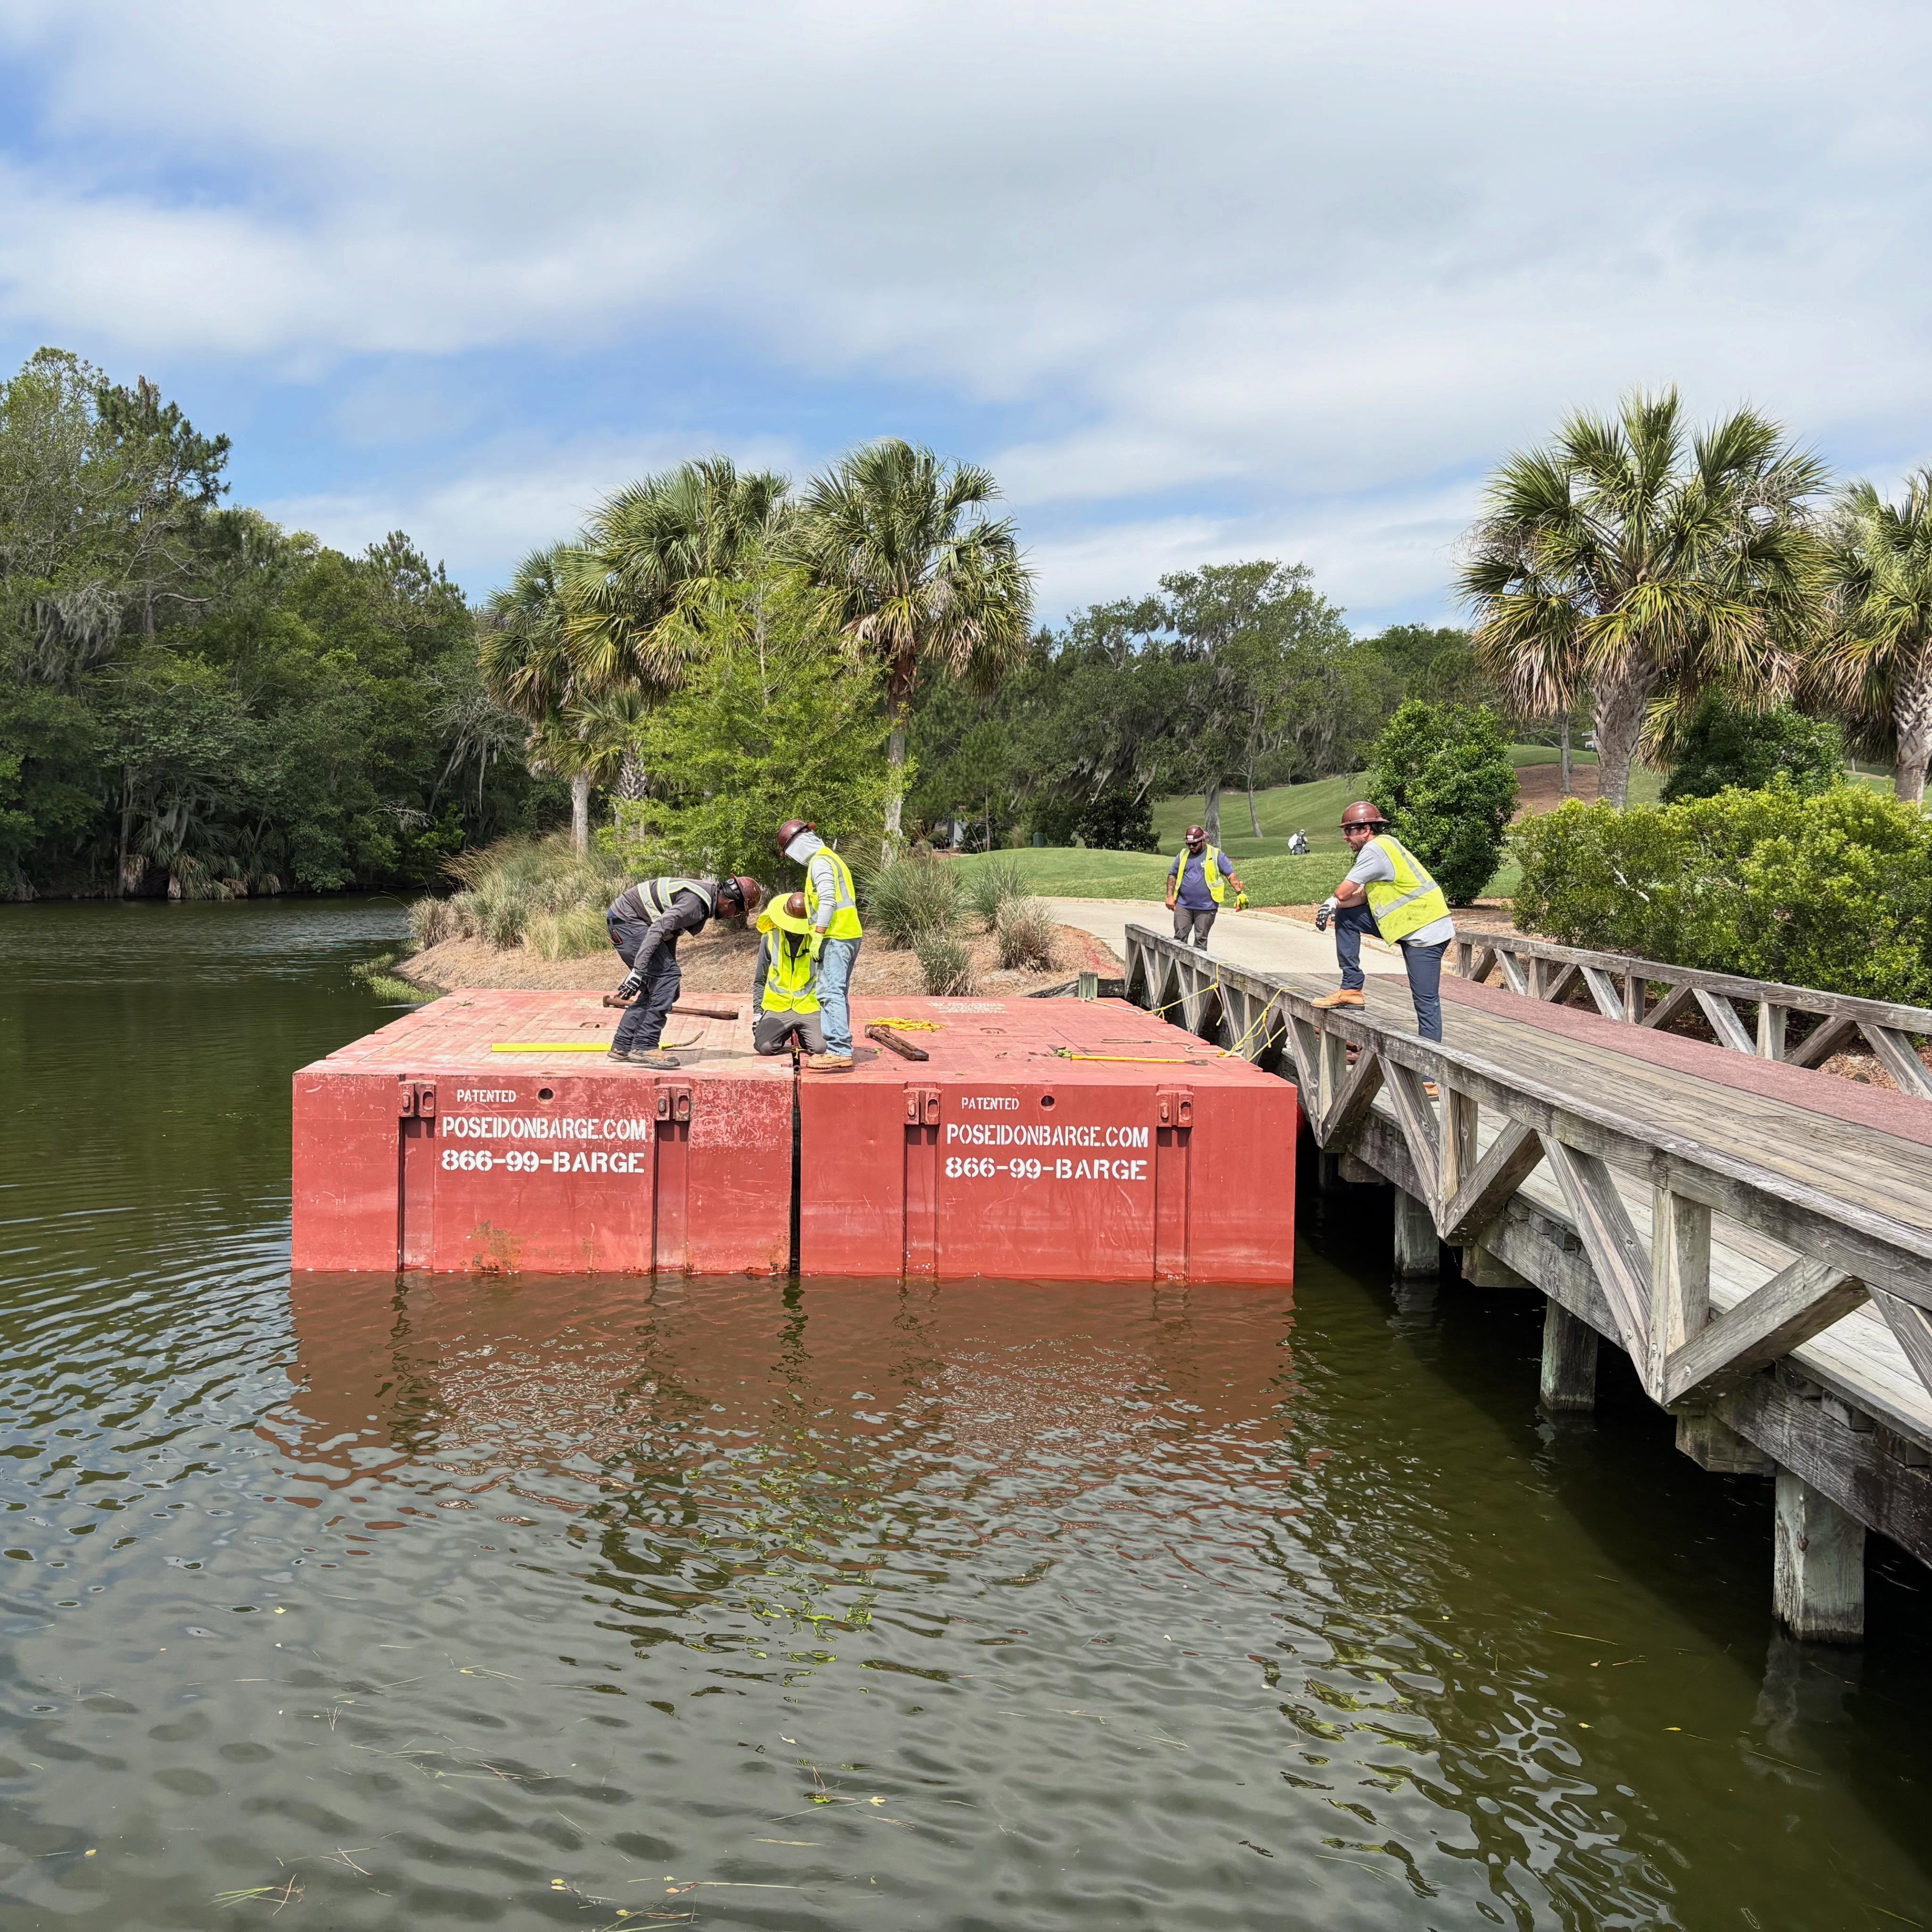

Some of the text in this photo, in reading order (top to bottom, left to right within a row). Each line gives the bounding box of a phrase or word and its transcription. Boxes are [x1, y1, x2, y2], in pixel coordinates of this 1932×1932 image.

[457, 1089, 516, 1103] PATENTED
[962, 1097, 1019, 1110] PATENTED
[442, 1116, 646, 1140] POSEIDONBARGE.COM
[947, 1124, 1149, 1148] POSEIDONBARGE.COM
[441, 1149, 645, 1173] 866-99-BARGE
[945, 1157, 1147, 1180] 866-99-BARGE
